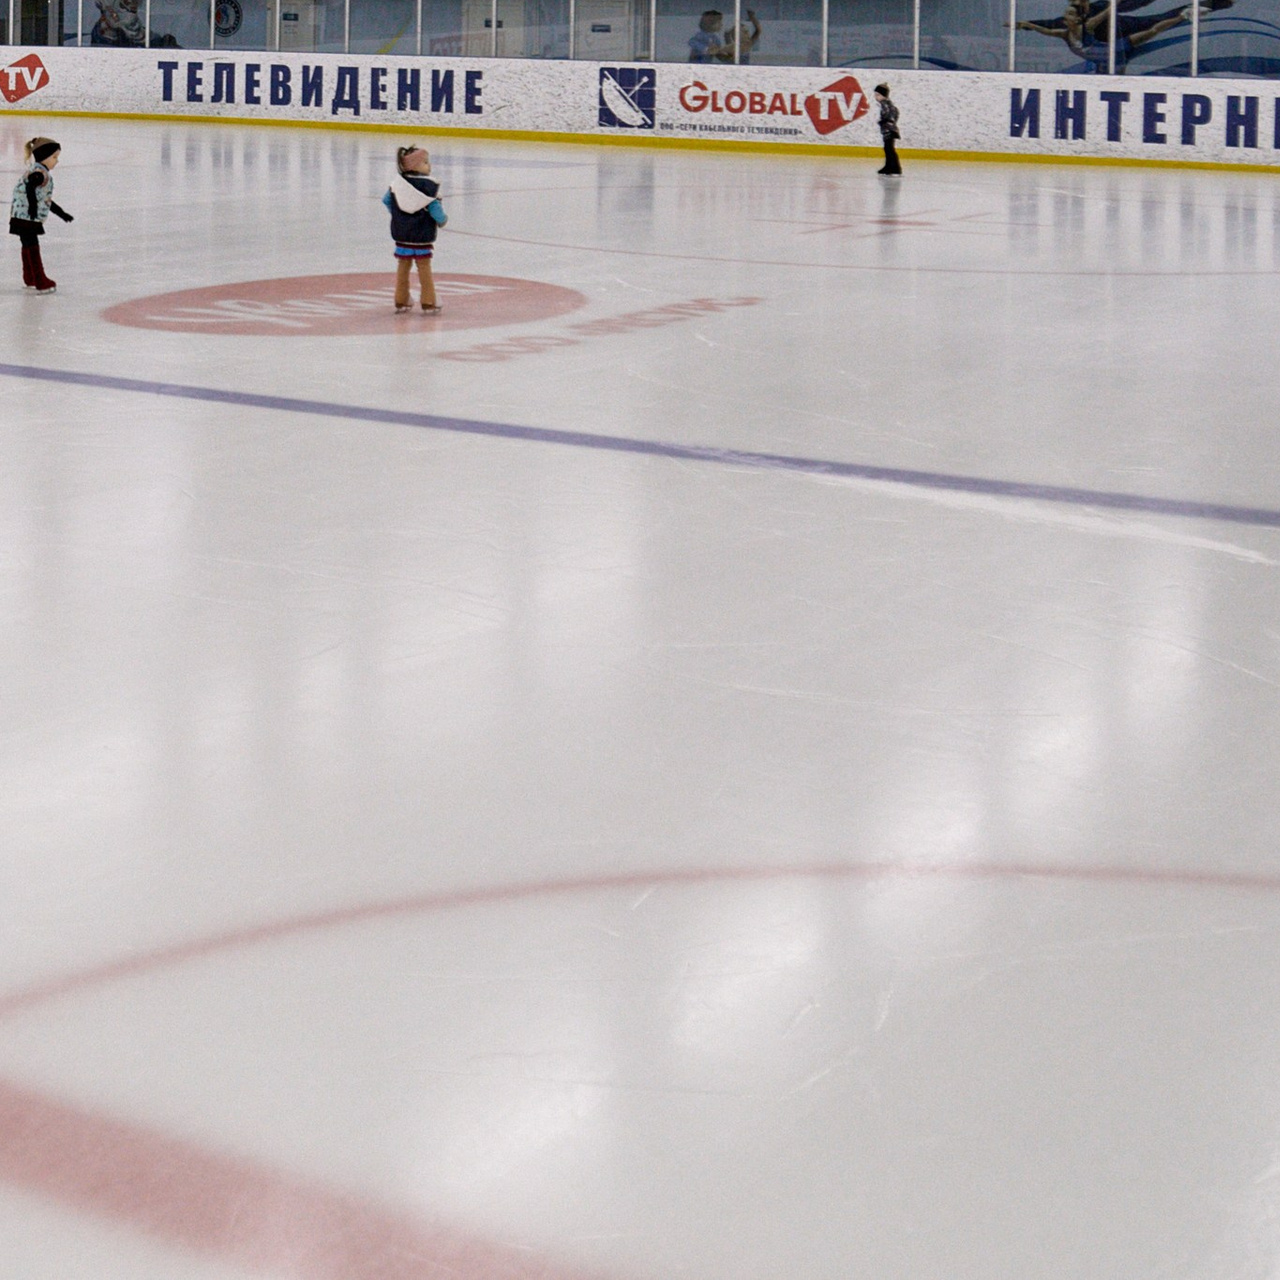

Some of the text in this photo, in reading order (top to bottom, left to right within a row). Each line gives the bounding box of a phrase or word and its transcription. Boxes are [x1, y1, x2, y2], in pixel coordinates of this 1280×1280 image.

[4, 66, 44, 91] TV
[157, 61, 484, 116] ТЕЛЕВИДЕНИЕ
[679, 80, 863, 121] GLOBAL TV
[1009, 87, 1280, 150] ИНТЕРН
